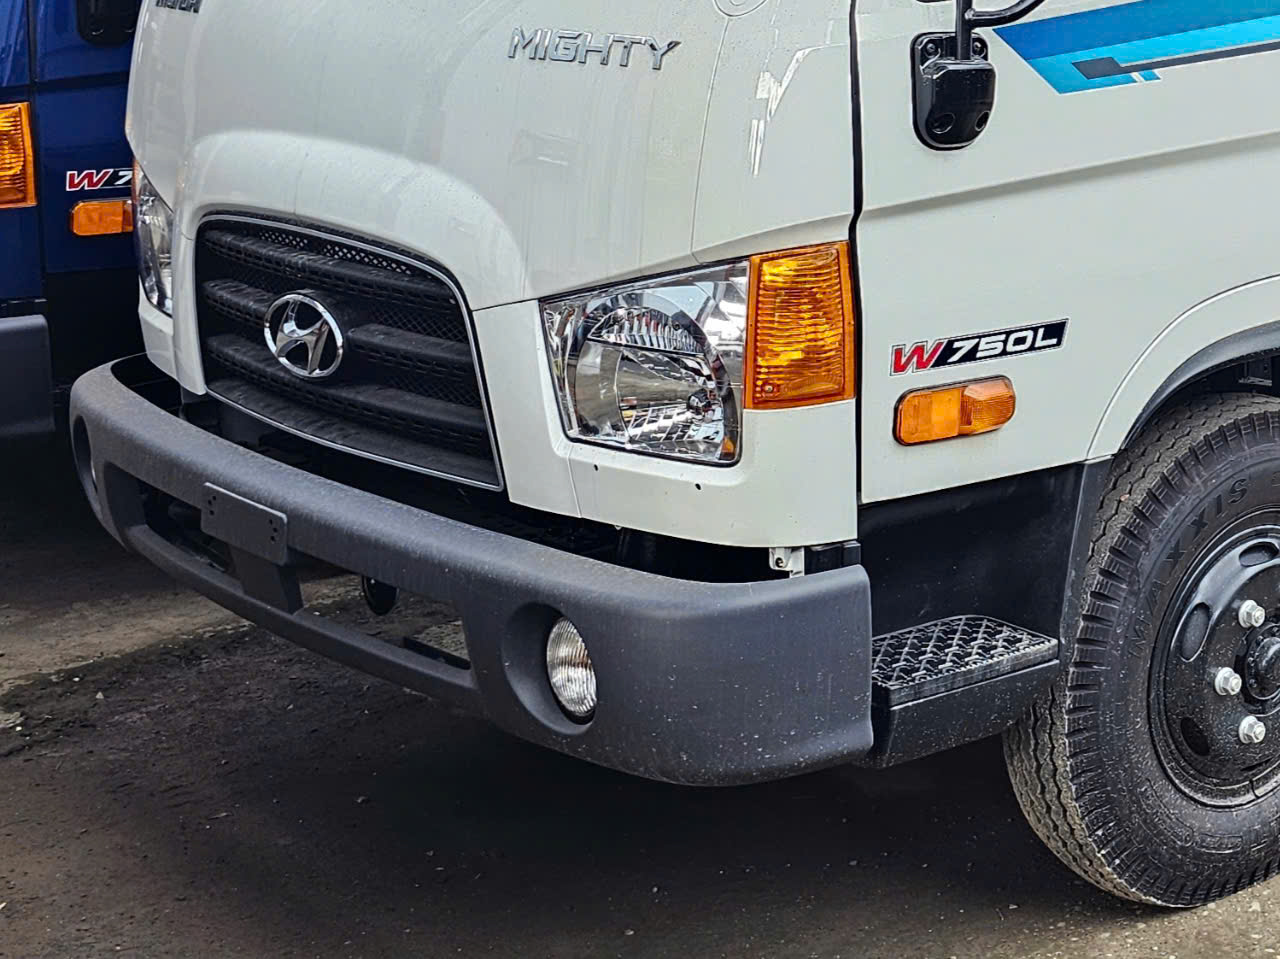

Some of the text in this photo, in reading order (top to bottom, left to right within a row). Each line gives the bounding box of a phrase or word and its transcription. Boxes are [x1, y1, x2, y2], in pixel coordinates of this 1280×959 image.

[508, 26, 681, 71] MIGHTY
[890, 327, 1058, 375] W750L
[1127, 477, 1249, 656] MAXXIS
